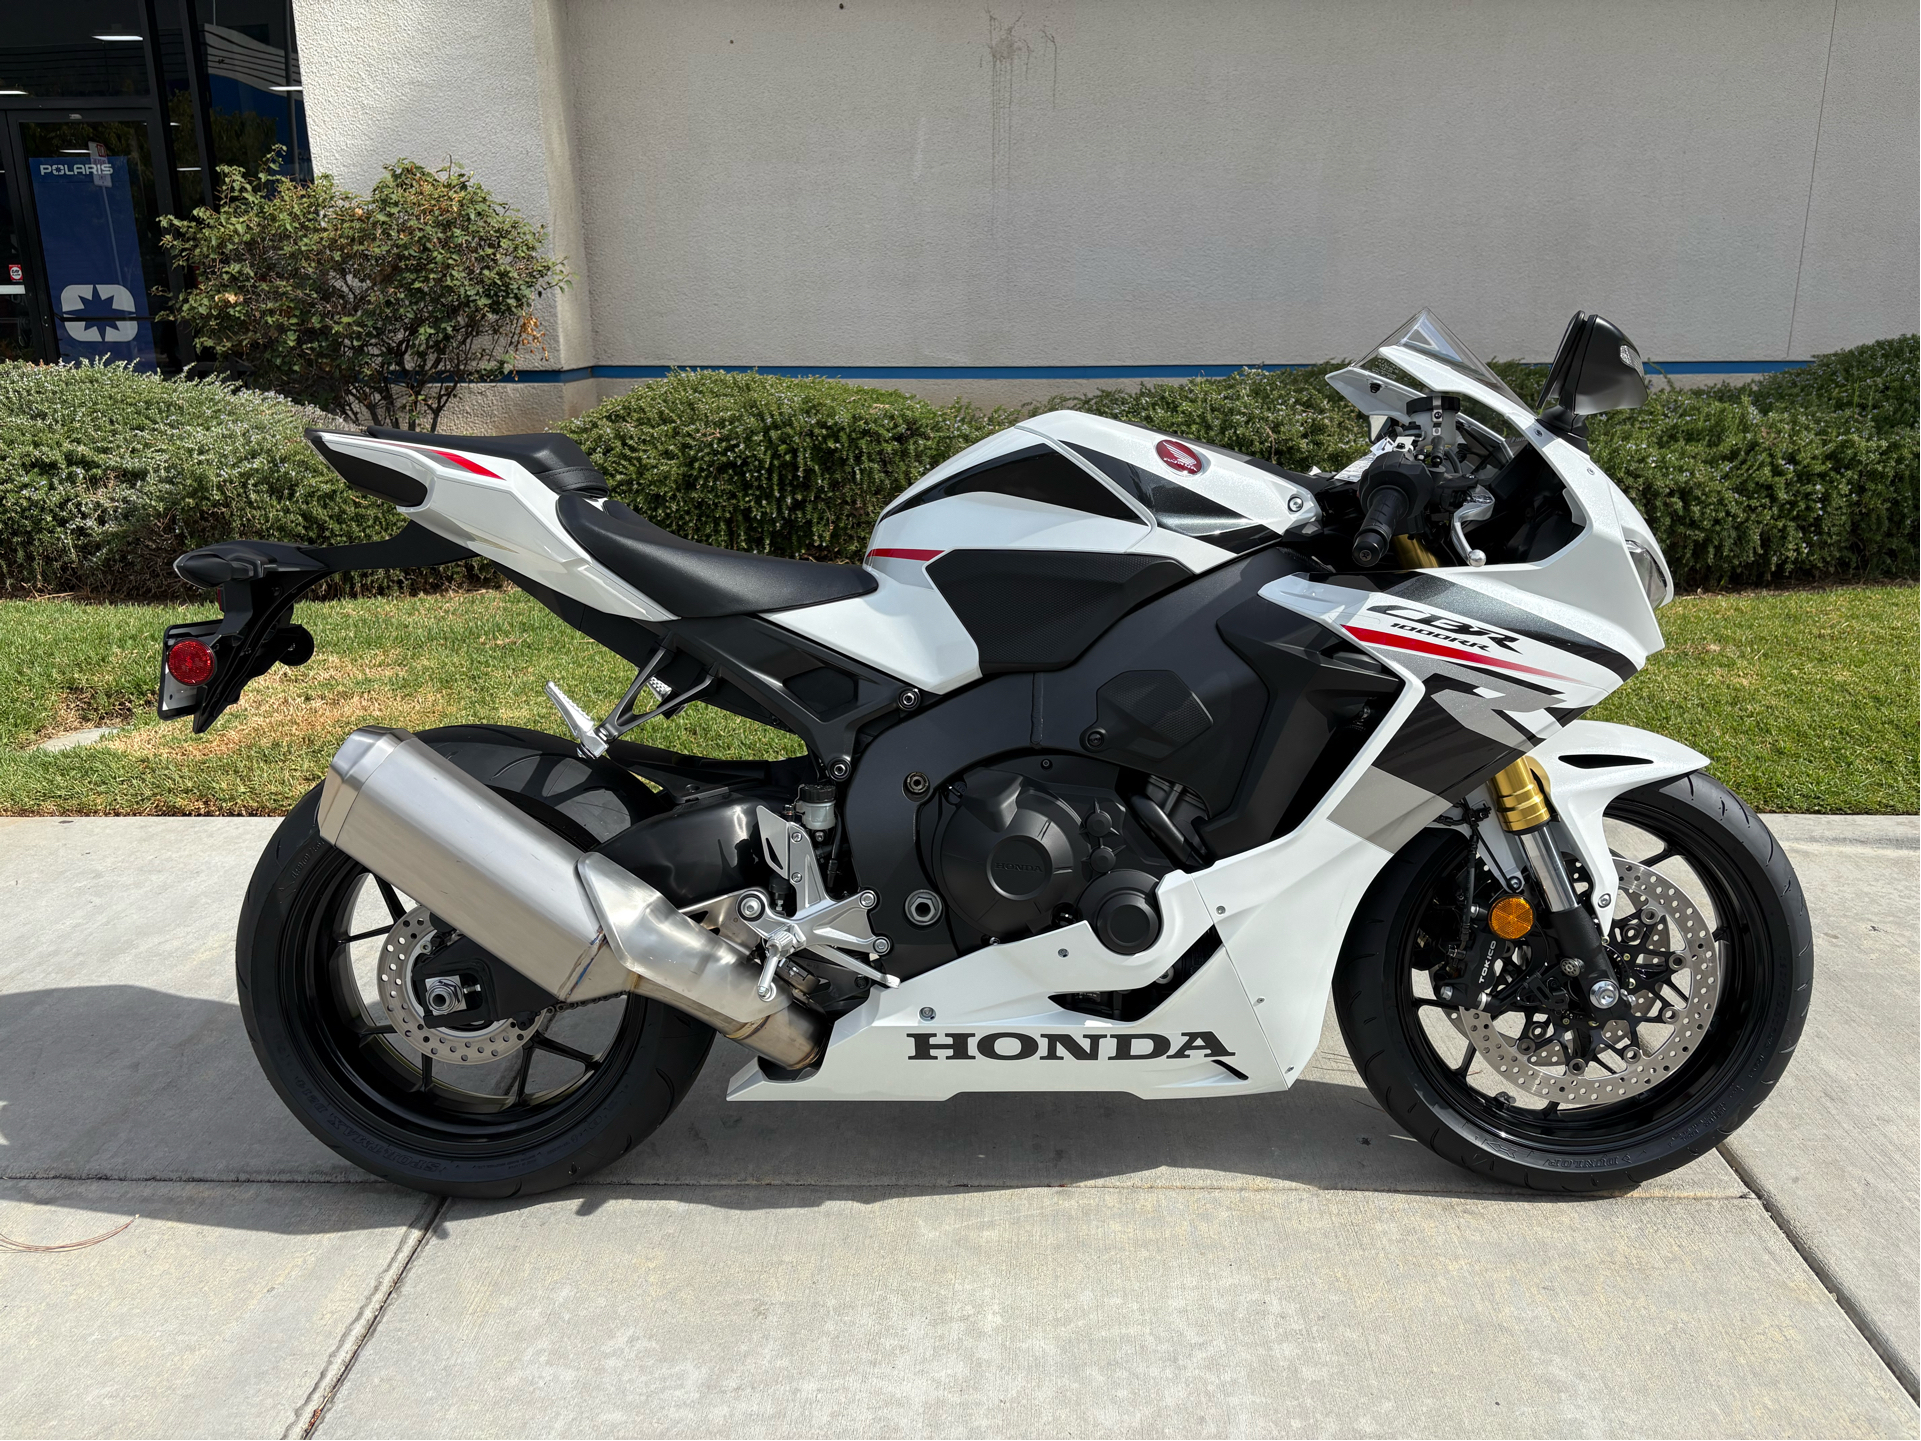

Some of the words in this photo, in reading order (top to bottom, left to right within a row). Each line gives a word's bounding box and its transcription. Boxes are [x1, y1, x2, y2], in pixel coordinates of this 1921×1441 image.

[40, 164, 113, 175] POLARIS
[1366, 605, 1523, 655] CBR
[1390, 622, 1491, 653] 1000RR
[995, 862, 1043, 873] HONDA
[1478, 940, 1497, 984] TOKICO
[906, 1031, 1236, 1061] HONDA
[326, 1112, 441, 1174] SPORTMAX
[1549, 1155, 1618, 1169] DUNLOP
